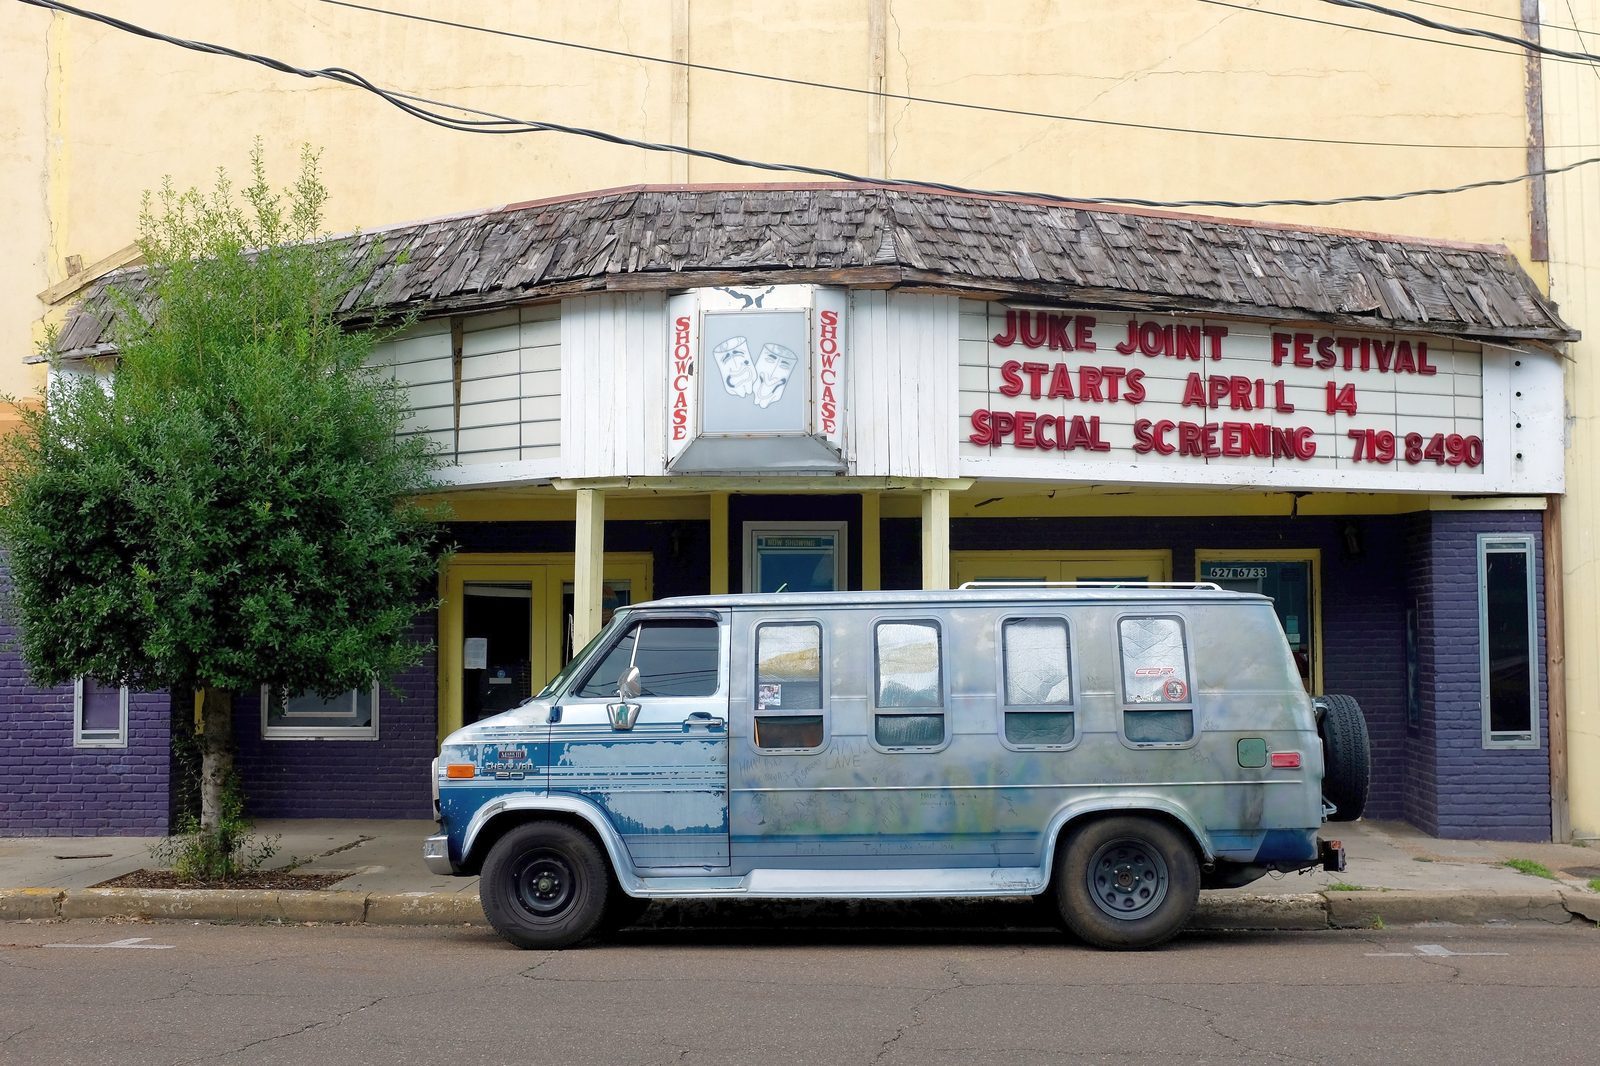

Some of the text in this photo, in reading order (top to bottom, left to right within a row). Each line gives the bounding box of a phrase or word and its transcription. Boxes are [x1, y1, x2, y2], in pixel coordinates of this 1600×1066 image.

[820, 310, 841, 434] SHOWCASE
[993, 310, 1437, 375] JUKE JOINT FESTIVAL
[673, 316, 692, 441] SHOWCASE
[998, 359, 1358, 417] STARTS APRIL 14
[969, 408, 1484, 468] SPECIAL SCREENING 719 8490
[1211, 568, 1267, 577] 627 6733
[485, 761, 514, 770] CHEVY
[495, 771, 524, 779] 20
